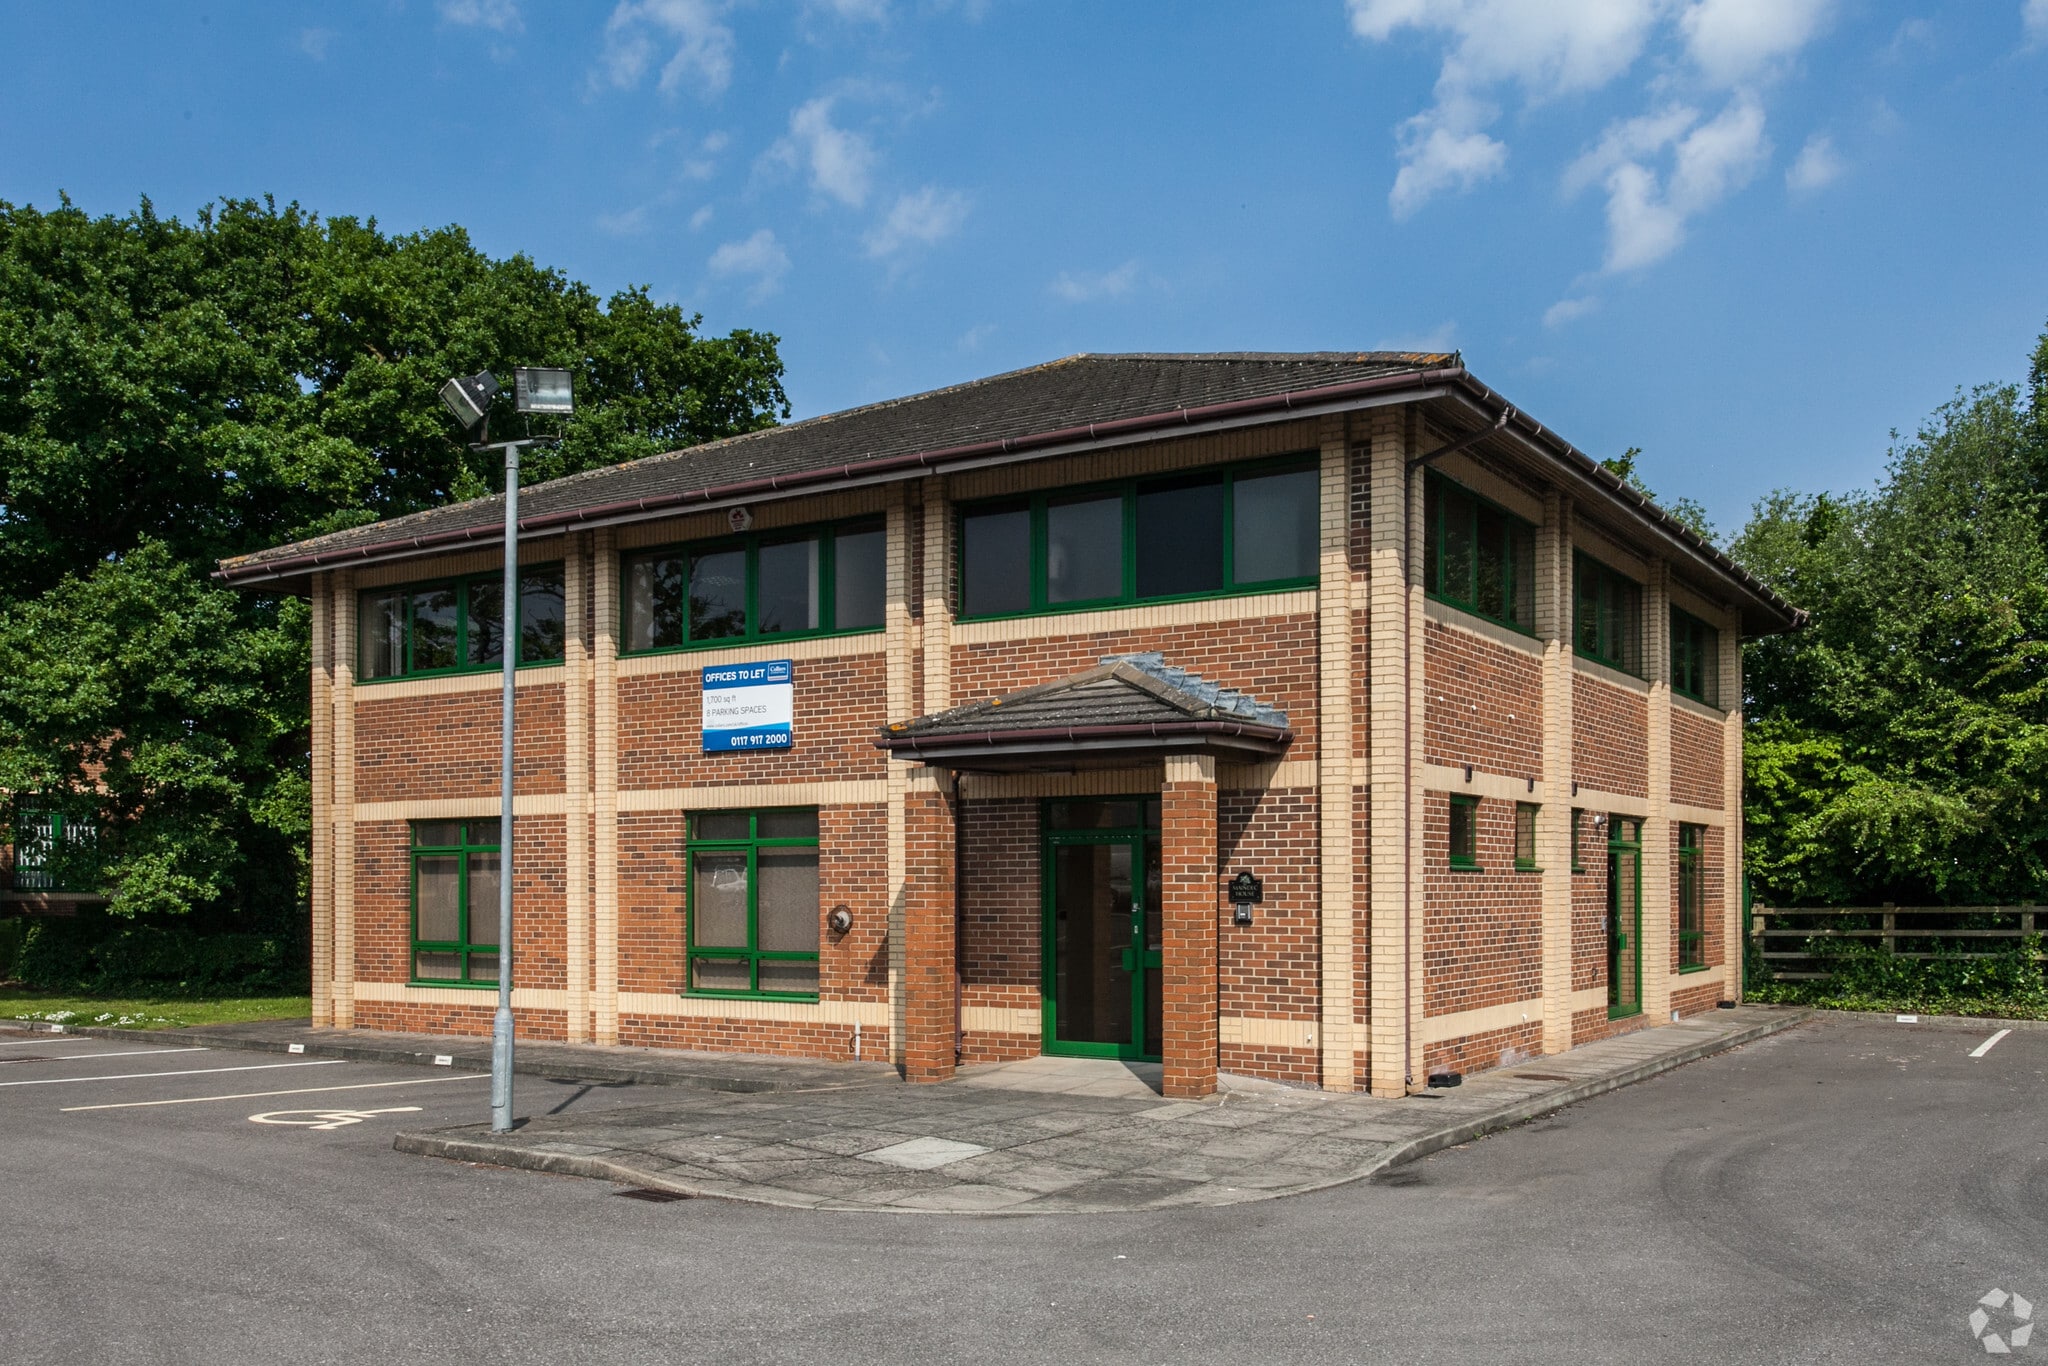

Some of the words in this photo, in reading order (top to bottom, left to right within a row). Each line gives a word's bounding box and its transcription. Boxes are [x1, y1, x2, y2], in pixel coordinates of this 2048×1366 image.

[705, 672, 736, 682] OFFICES
[738, 670, 749, 680] TO
[750, 668, 765, 679] LET
[706, 709, 711, 717] 8
[712, 707, 739, 716] PARKING
[740, 705, 767, 715] SPACES
[731, 736, 747, 746] 0117
[750, 734, 763, 745] 917
[765, 733, 787, 744] 2000
